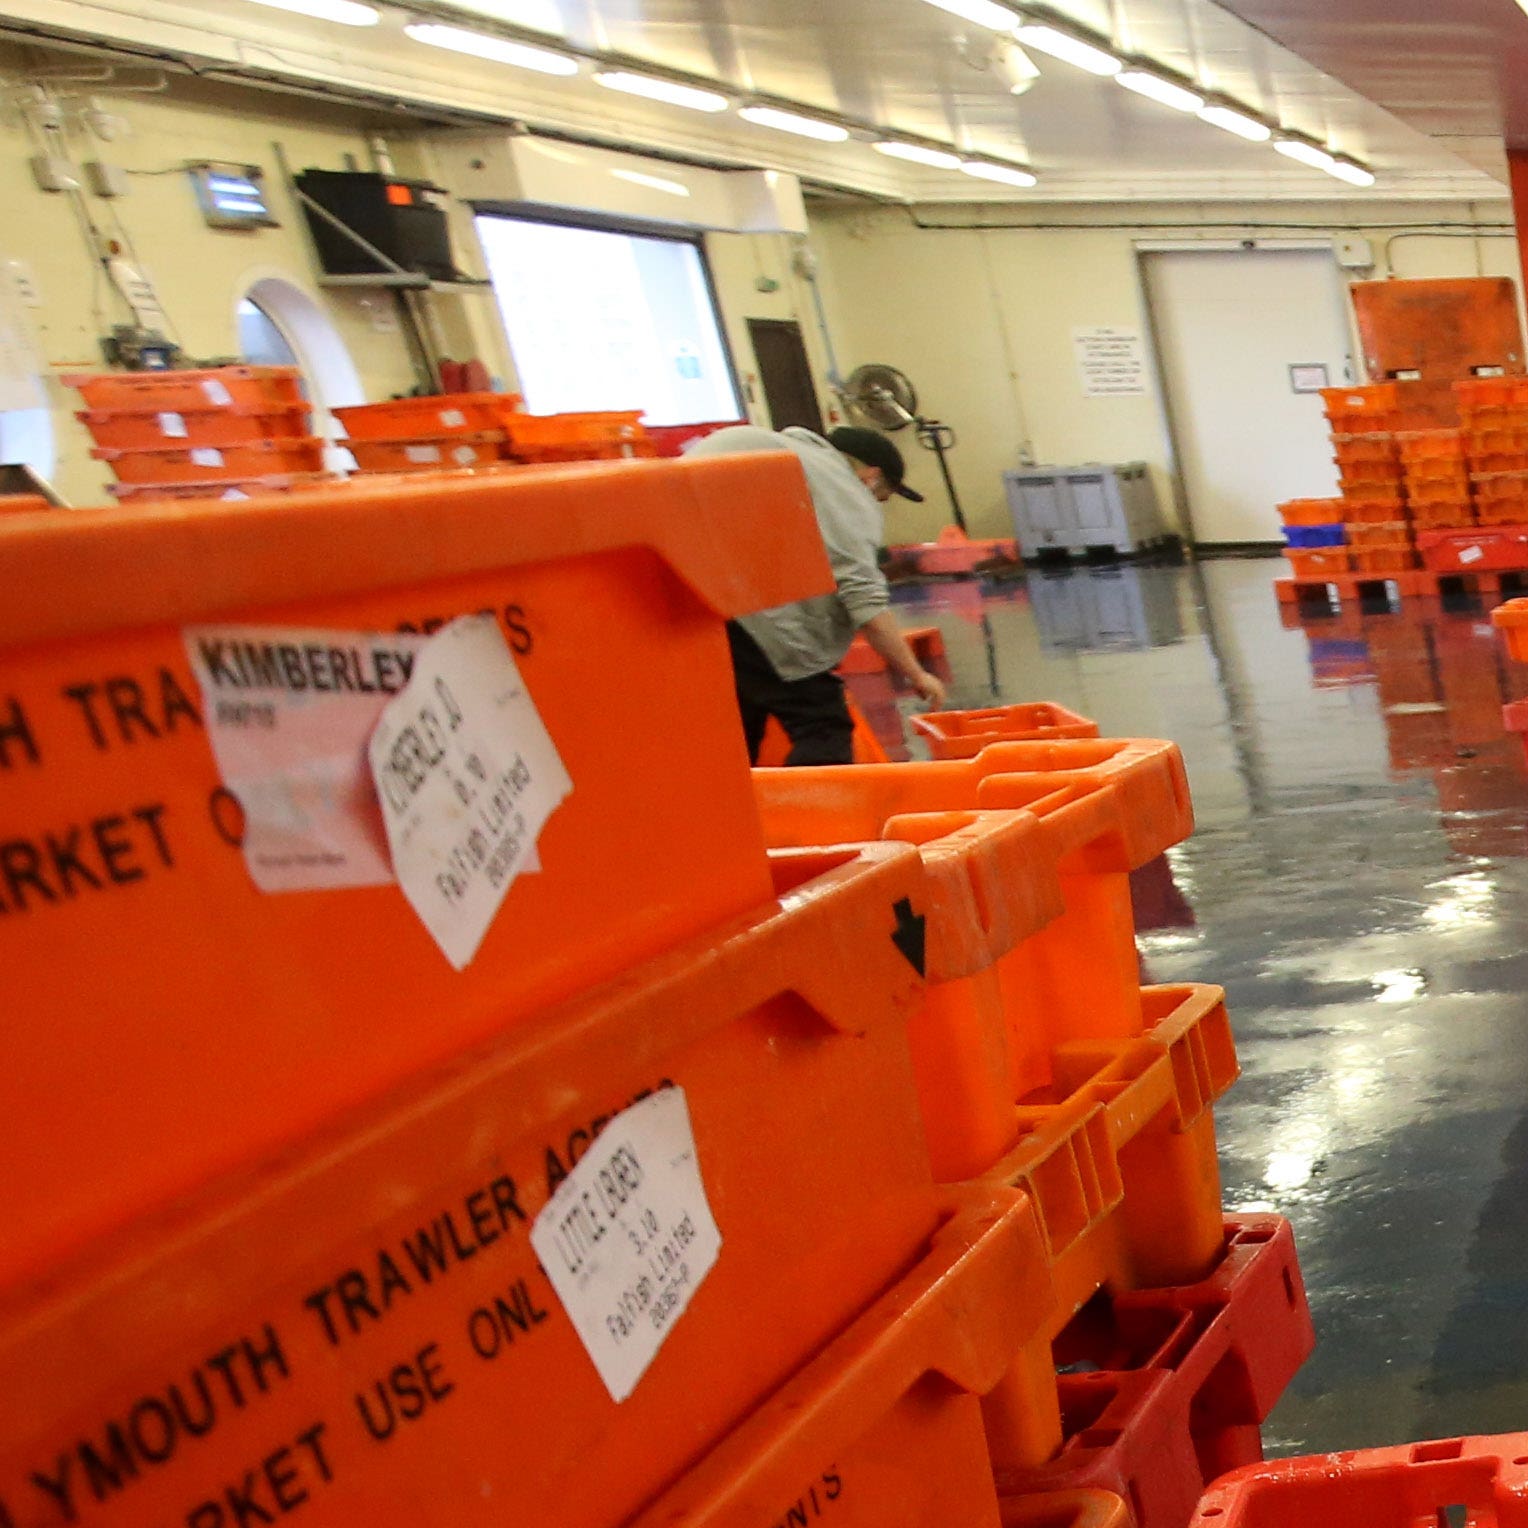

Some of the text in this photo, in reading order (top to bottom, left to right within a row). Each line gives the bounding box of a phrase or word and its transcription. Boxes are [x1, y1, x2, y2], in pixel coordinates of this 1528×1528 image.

[198, 636, 414, 693] KIMBERLEY
[0, 802, 174, 915] RKET
[306, 1176, 526, 1347] TRAWLER
[354, 1352, 456, 1443] USE
[466, 1283, 548, 1364] ONL
